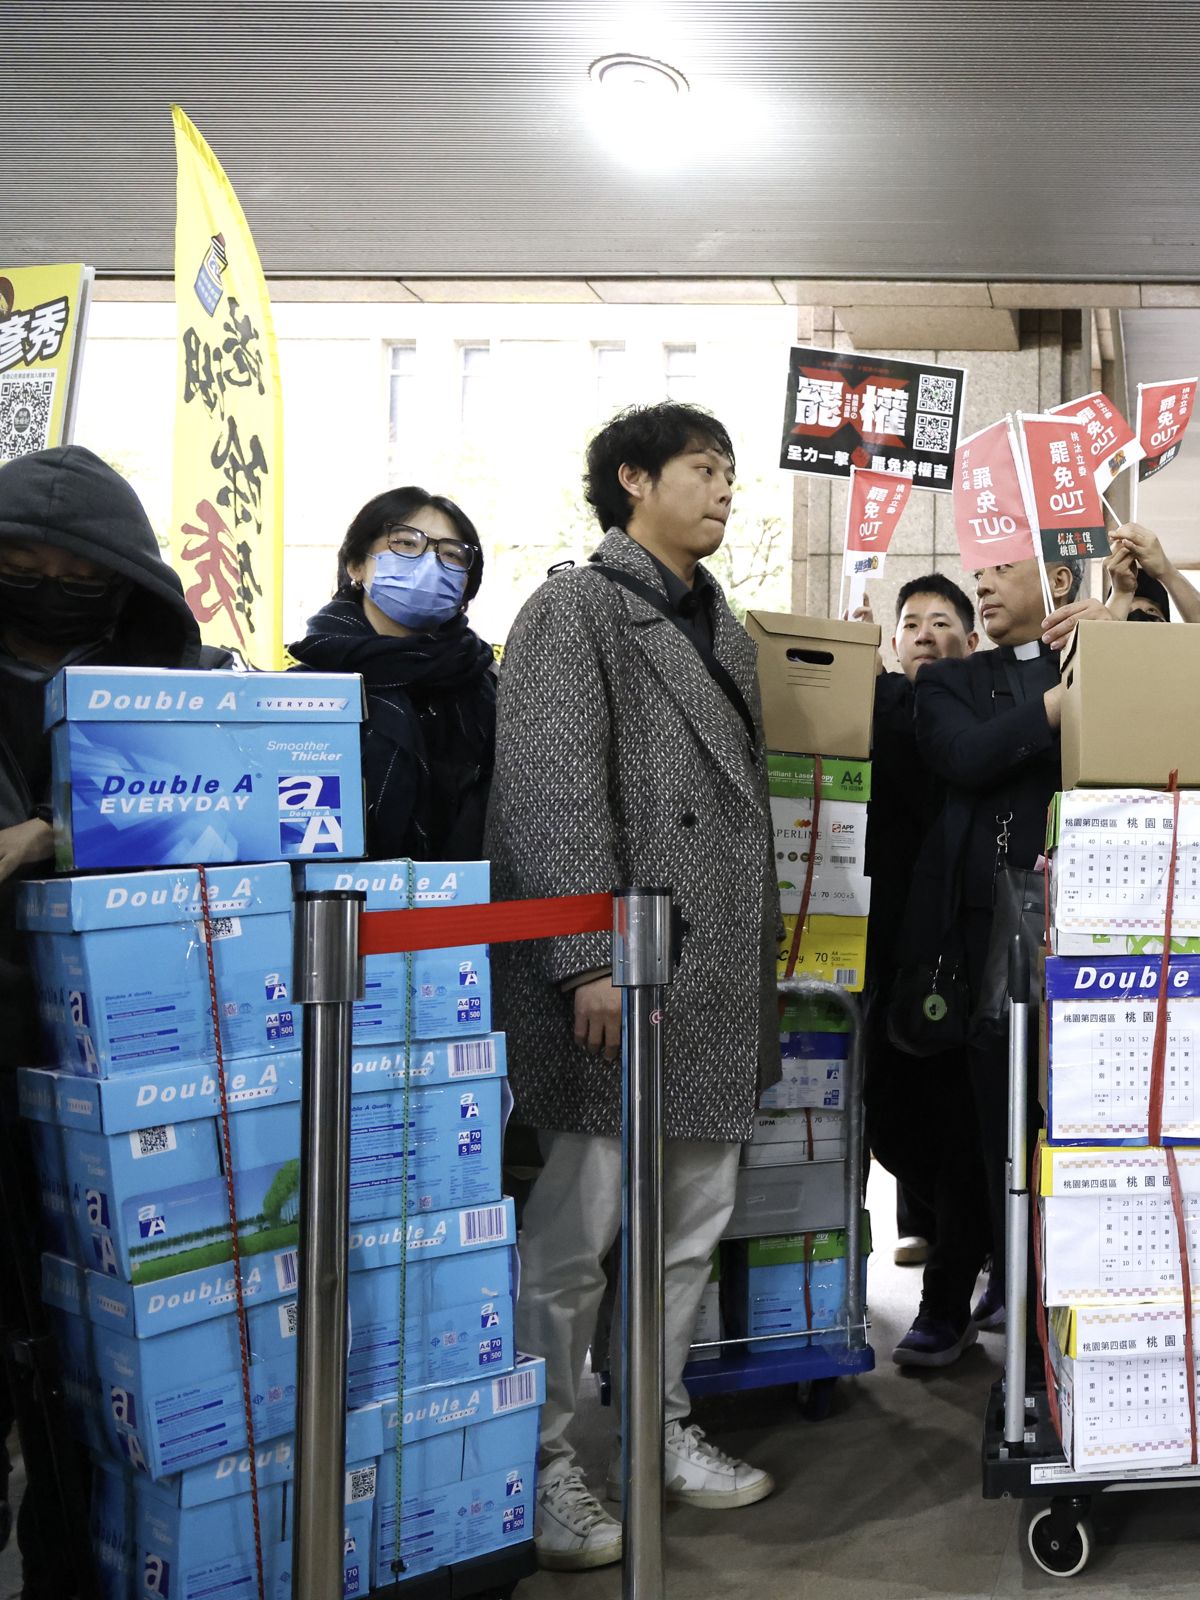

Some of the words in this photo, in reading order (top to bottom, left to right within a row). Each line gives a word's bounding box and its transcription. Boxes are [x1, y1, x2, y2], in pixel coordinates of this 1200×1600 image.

[1158, 395, 1177, 429] 罷免
[1091, 426, 1115, 455] OUT
[1150, 424, 1180, 446] OUT
[787, 445, 850, 467] 全力一擊
[1070, 432, 1087, 477] 桃汰立委
[1049, 440, 1075, 490] 罷免
[1050, 490, 1086, 511] OUT
[859, 521, 883, 537] OUT
[88, 690, 205, 710] Double
[217, 691, 237, 711] A
[256, 701, 336, 709] EVERYDAY
[266, 740, 329, 751] Smoother
[290, 751, 342, 761] Thicker
[102, 774, 220, 796] Double
[233, 774, 253, 794] A
[841, 770, 863, 785] A4
[100, 795, 250, 815] EVERYDAY
[1127, 817, 1174, 829] 桃園區
[334, 873, 430, 892] Doube
[441, 872, 458, 890] A
[106, 881, 220, 909] Double
[232, 878, 251, 898] A
[815, 952, 828, 963] 70
[1074, 966, 1189, 990] Doube
[470, 998, 480, 1007] 70
[266, 1016, 279, 1025] A4
[280, 1013, 292, 1022] 70
[469, 1010, 481, 1019] 500
[280, 1025, 293, 1035] 500
[421, 1051, 435, 1066] A
[136, 1073, 246, 1107] Doube
[259, 1065, 278, 1085] A
[213, 1087, 270, 1104] EERYDAY
[459, 1133, 470, 1141] A4
[471, 1131, 481, 1139] 70
[470, 1143, 481, 1152] 500
[1063, 1179, 1117, 1189] 桃園第四選區
[433, 1220, 447, 1236] A
[148, 1274, 238, 1314] Double
[246, 1268, 262, 1284] A
[479, 1342, 490, 1351] A4
[491, 1337, 502, 1348] 70
[491, 1351, 502, 1359] 500
[464, 1389, 480, 1407] A
[514, 1504, 525, 1515] 70
